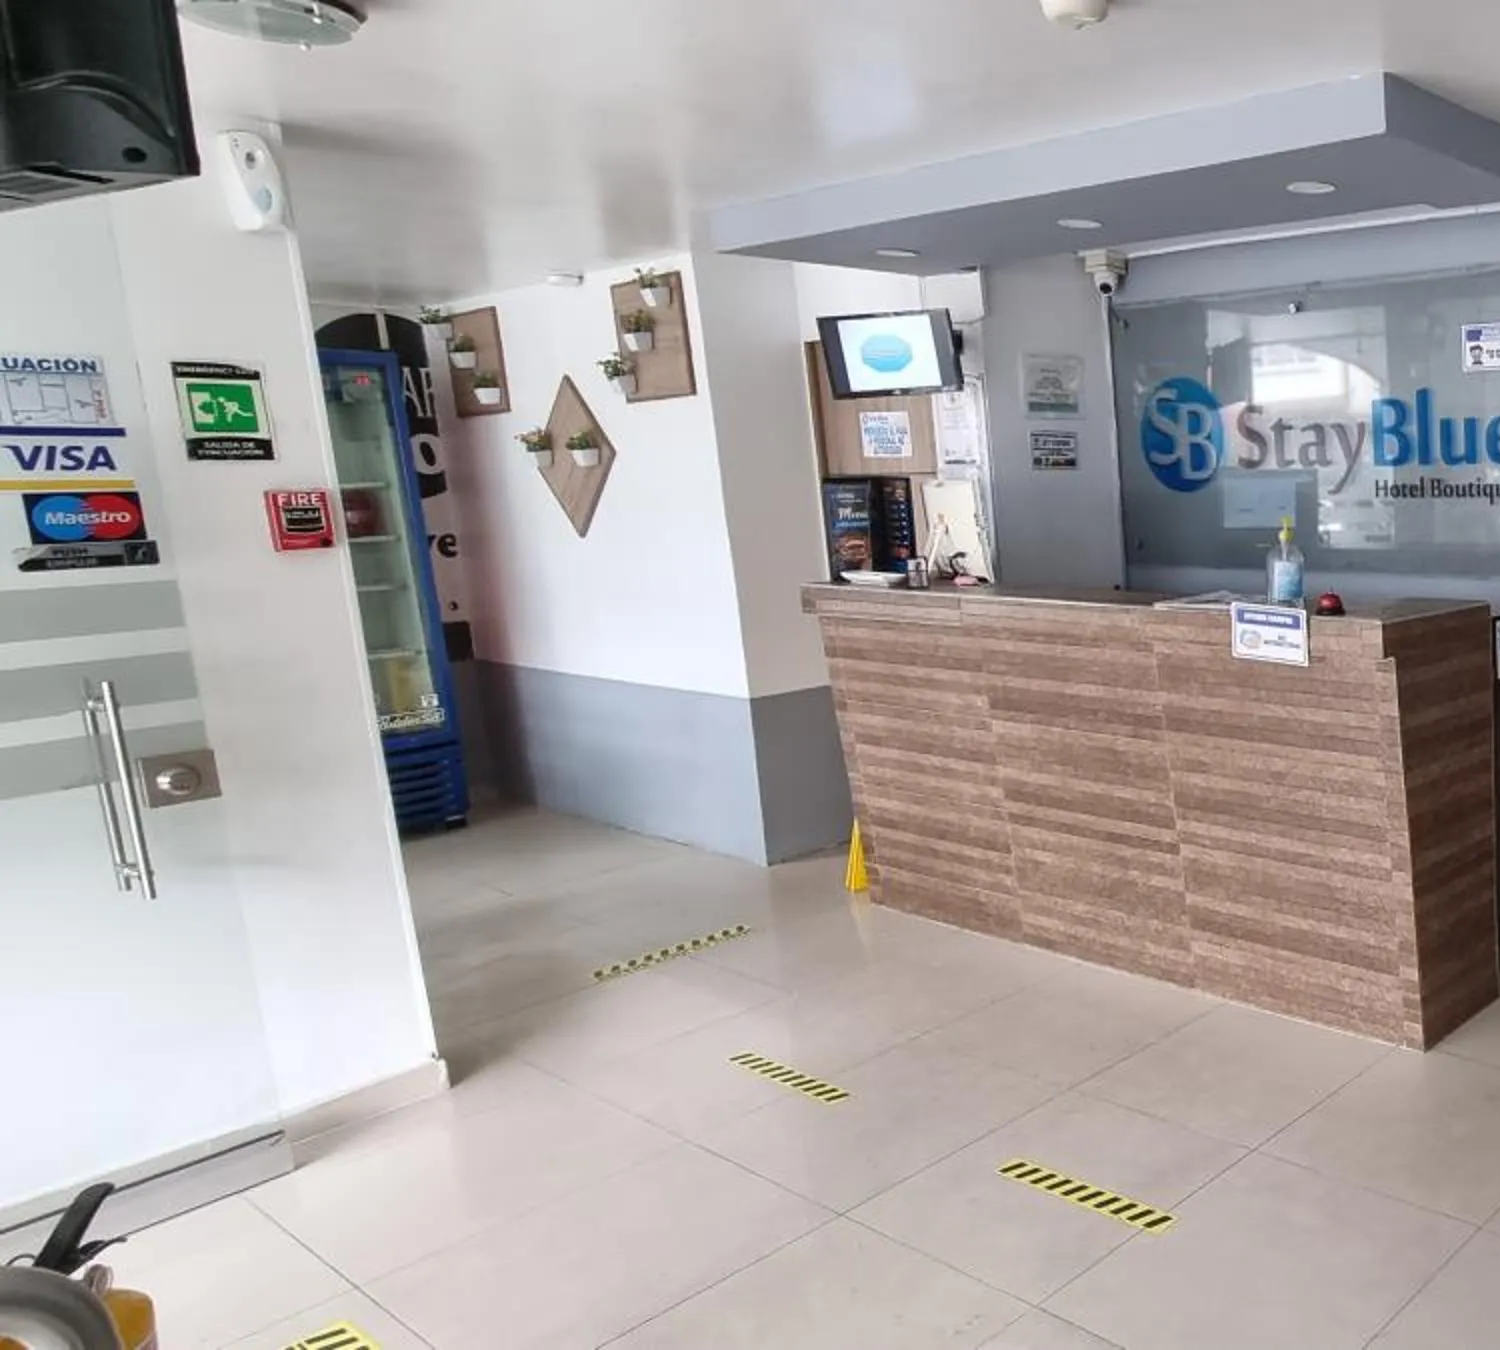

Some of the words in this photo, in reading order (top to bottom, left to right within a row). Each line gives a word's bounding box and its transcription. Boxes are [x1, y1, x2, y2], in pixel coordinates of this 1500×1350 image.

[2, 445, 117, 471] VISA
[1375, 475, 1426, 499] Hotel
[277, 492, 322, 507] FIRE
[45, 510, 132, 525] Maestro
